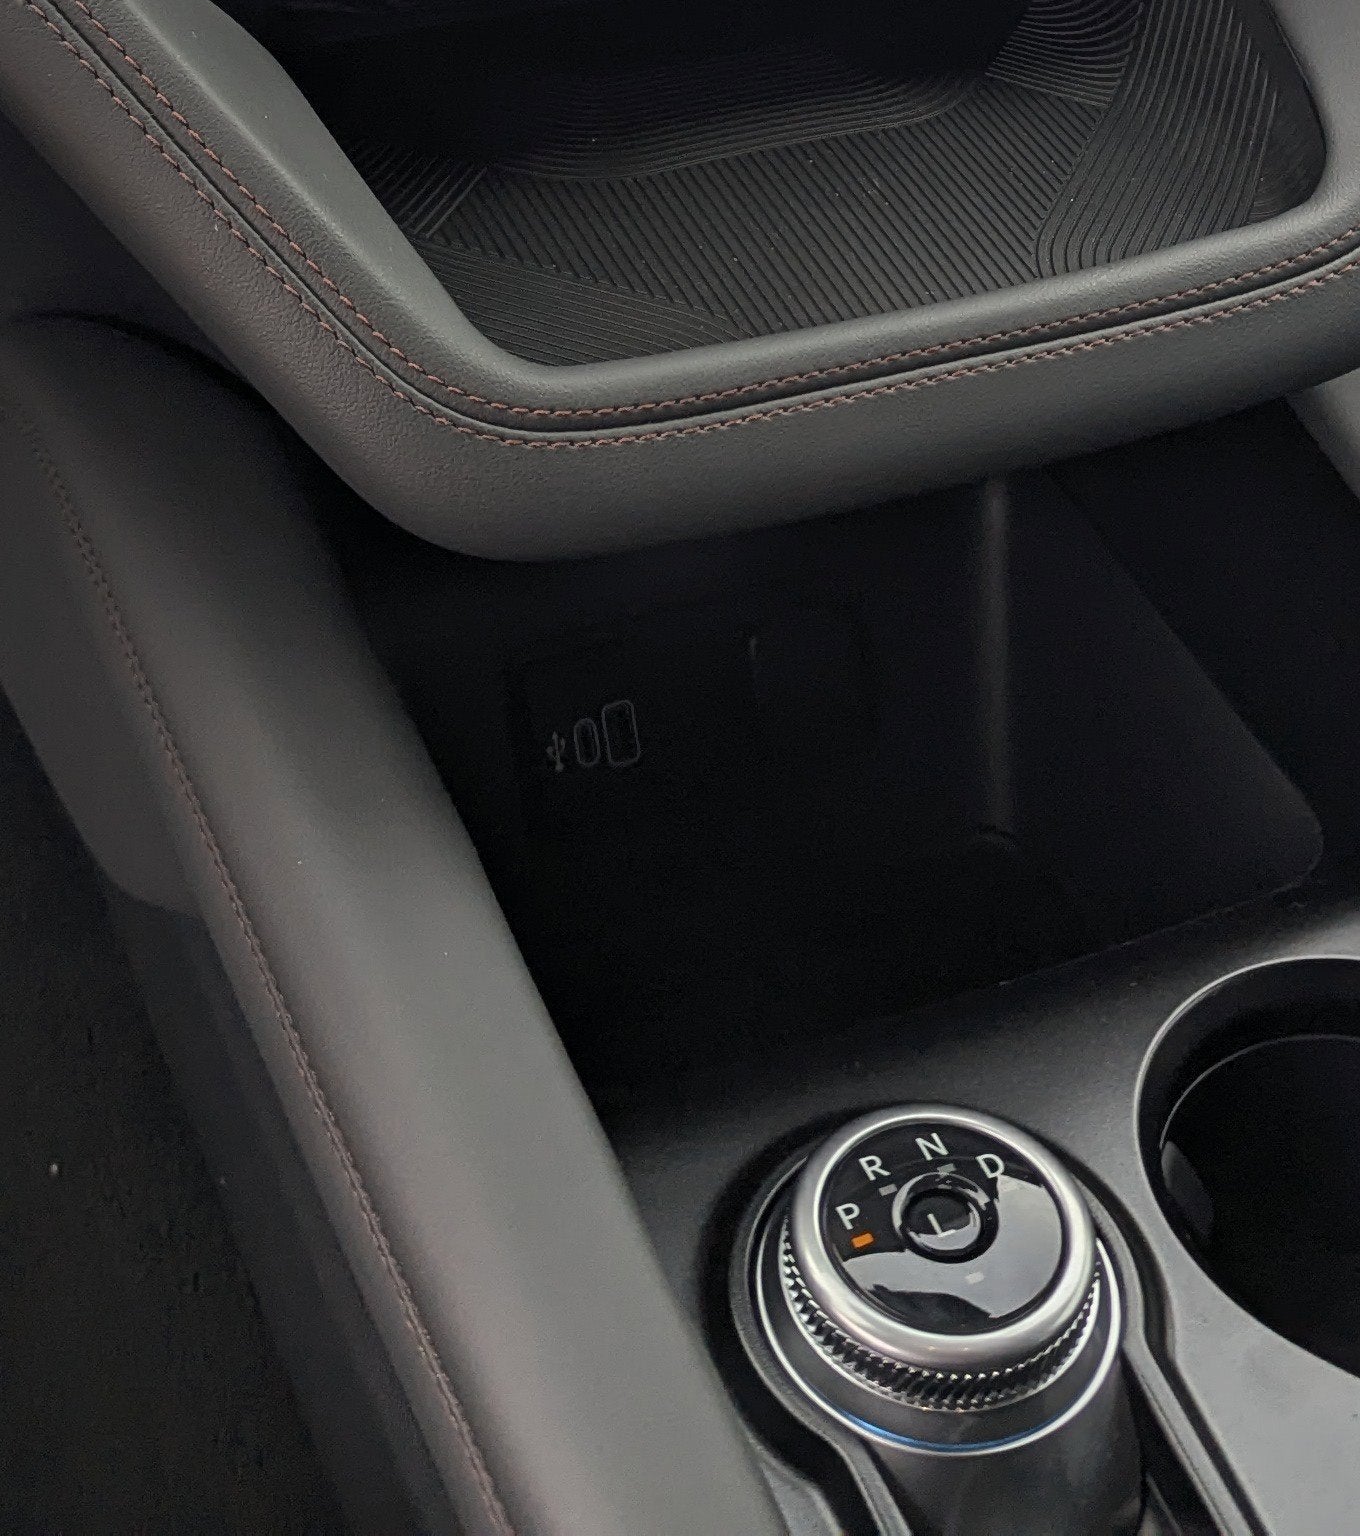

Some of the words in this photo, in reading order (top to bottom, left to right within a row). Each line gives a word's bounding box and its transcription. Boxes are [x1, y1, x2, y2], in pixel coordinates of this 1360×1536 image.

[915, 1132, 949, 1161] N
[858, 1154, 891, 1181] R
[975, 1153, 1005, 1179] D
[835, 1202, 860, 1231] P
